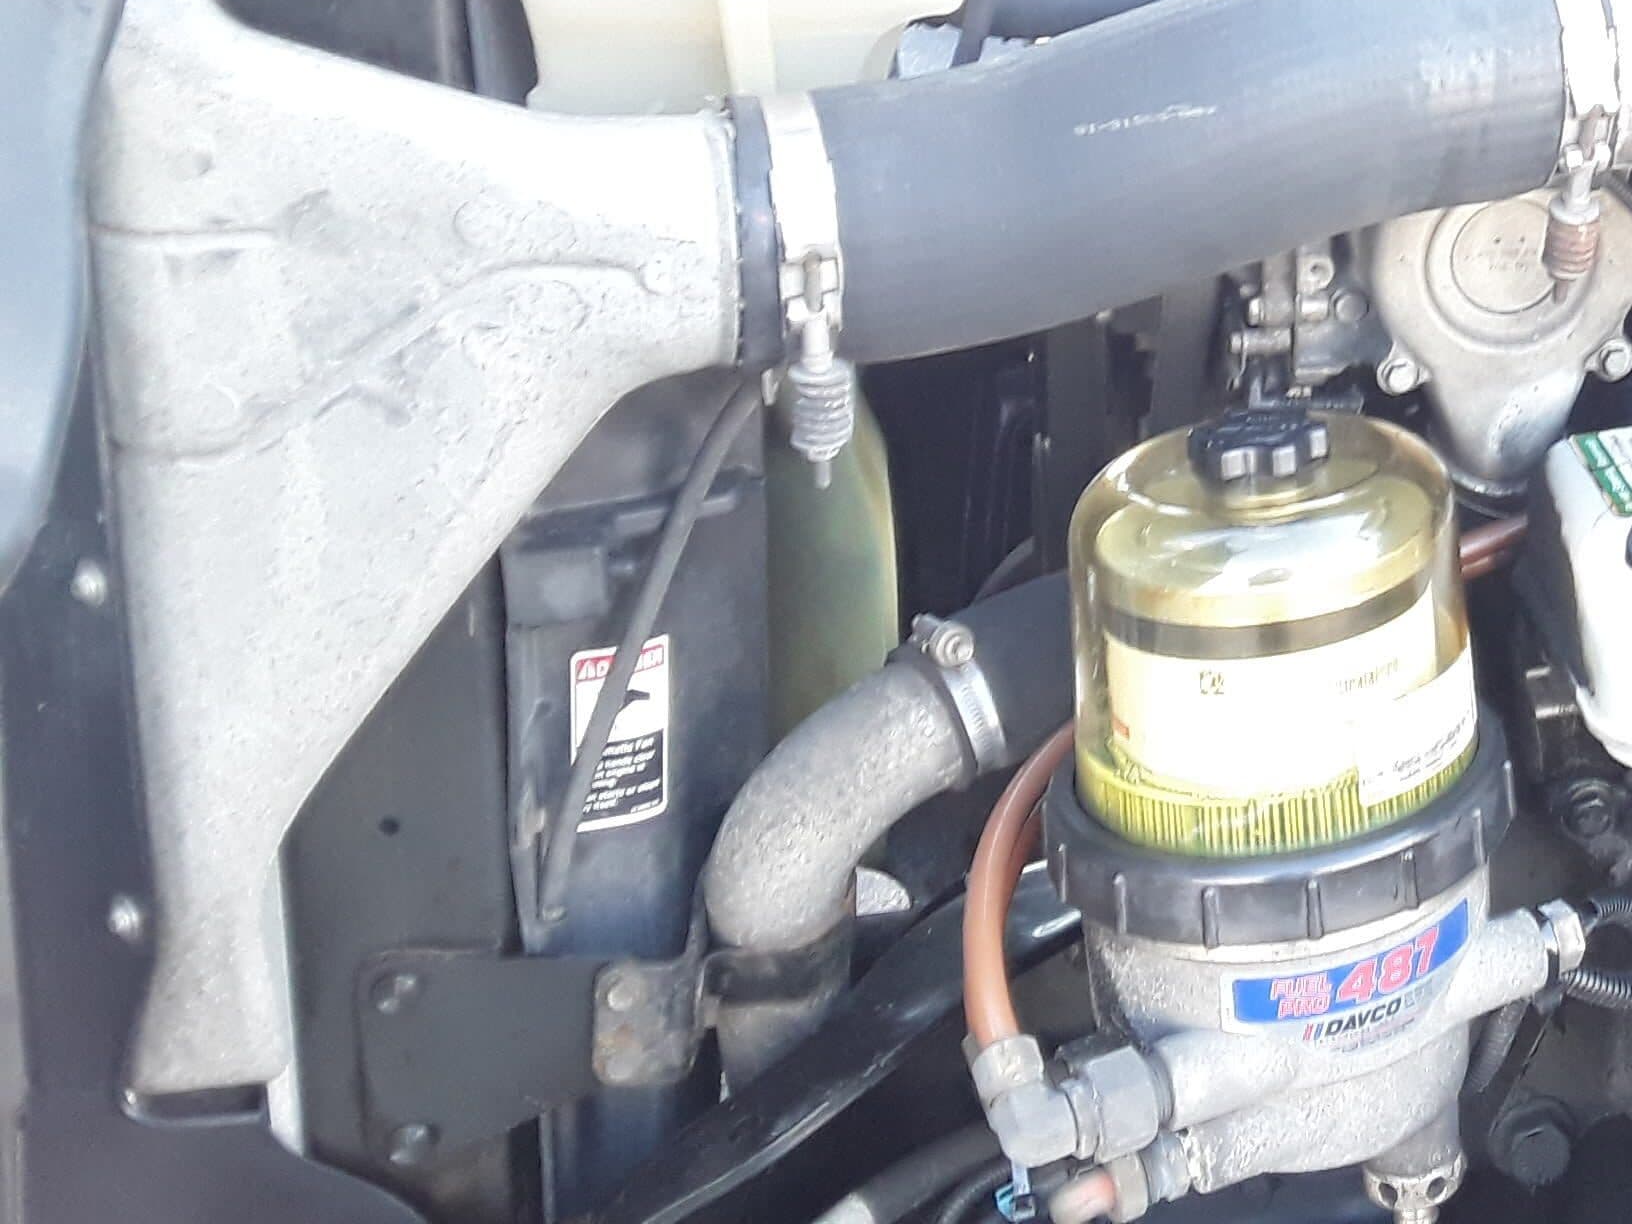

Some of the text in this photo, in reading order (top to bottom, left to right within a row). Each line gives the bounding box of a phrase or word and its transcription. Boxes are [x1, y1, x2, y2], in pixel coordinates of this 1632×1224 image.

[1336, 925, 1439, 1003] 487
[1270, 971, 1332, 1001] FUEL
[1278, 993, 1332, 1020] PRO
[1325, 997, 1401, 1037] DAVCO
